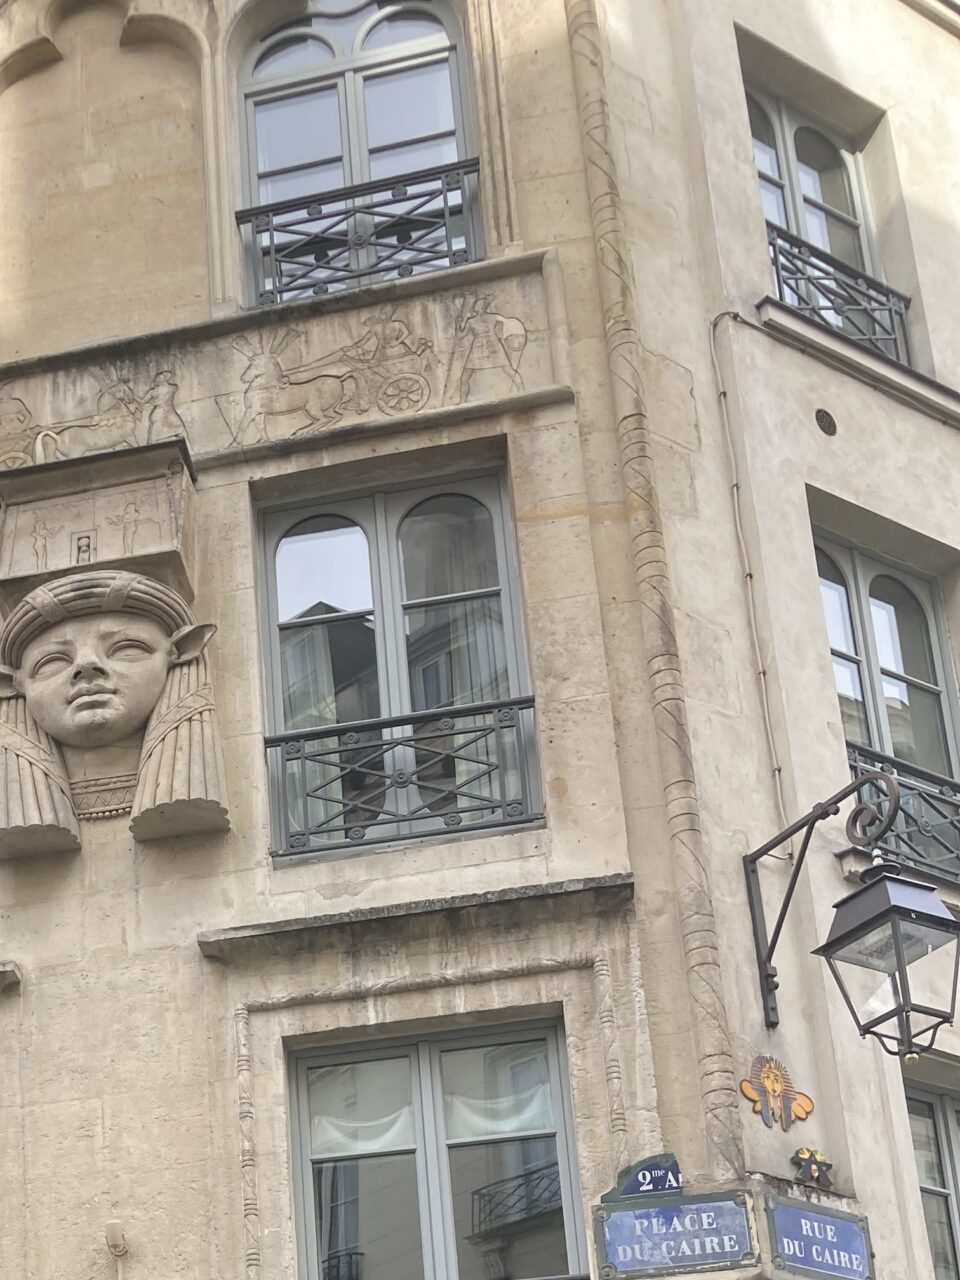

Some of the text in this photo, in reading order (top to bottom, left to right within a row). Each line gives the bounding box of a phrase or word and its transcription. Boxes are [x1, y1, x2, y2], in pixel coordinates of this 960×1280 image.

[634, 1212, 717, 1236] PLACE
[800, 1218, 837, 1242] RUE
[616, 1234, 739, 1262] DU CAIRE
[782, 1237, 863, 1272] DU CAIRE
